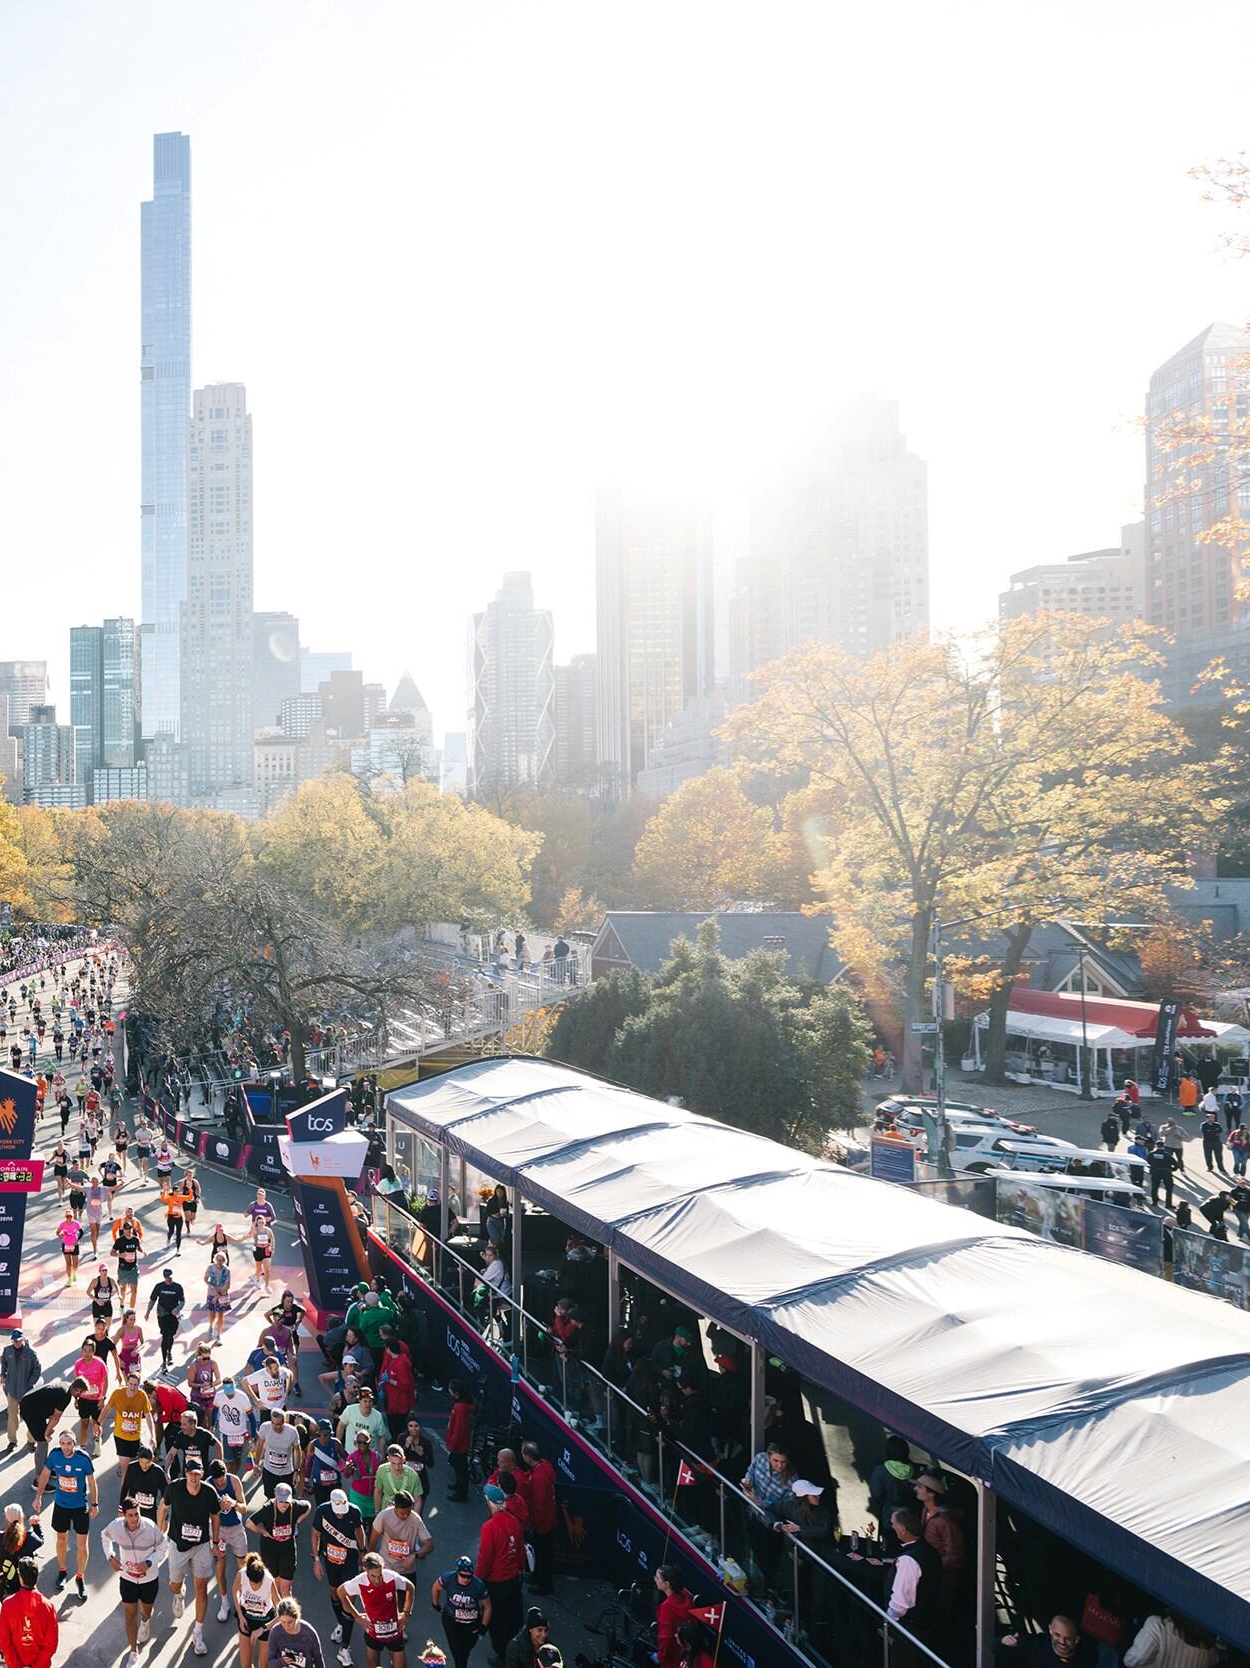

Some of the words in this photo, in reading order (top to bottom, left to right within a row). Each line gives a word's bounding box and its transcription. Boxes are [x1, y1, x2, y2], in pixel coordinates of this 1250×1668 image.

[307, 1113, 334, 1132] tcs
[263, 1135, 274, 1144] IT
[446, 1325, 461, 1357] tcs
